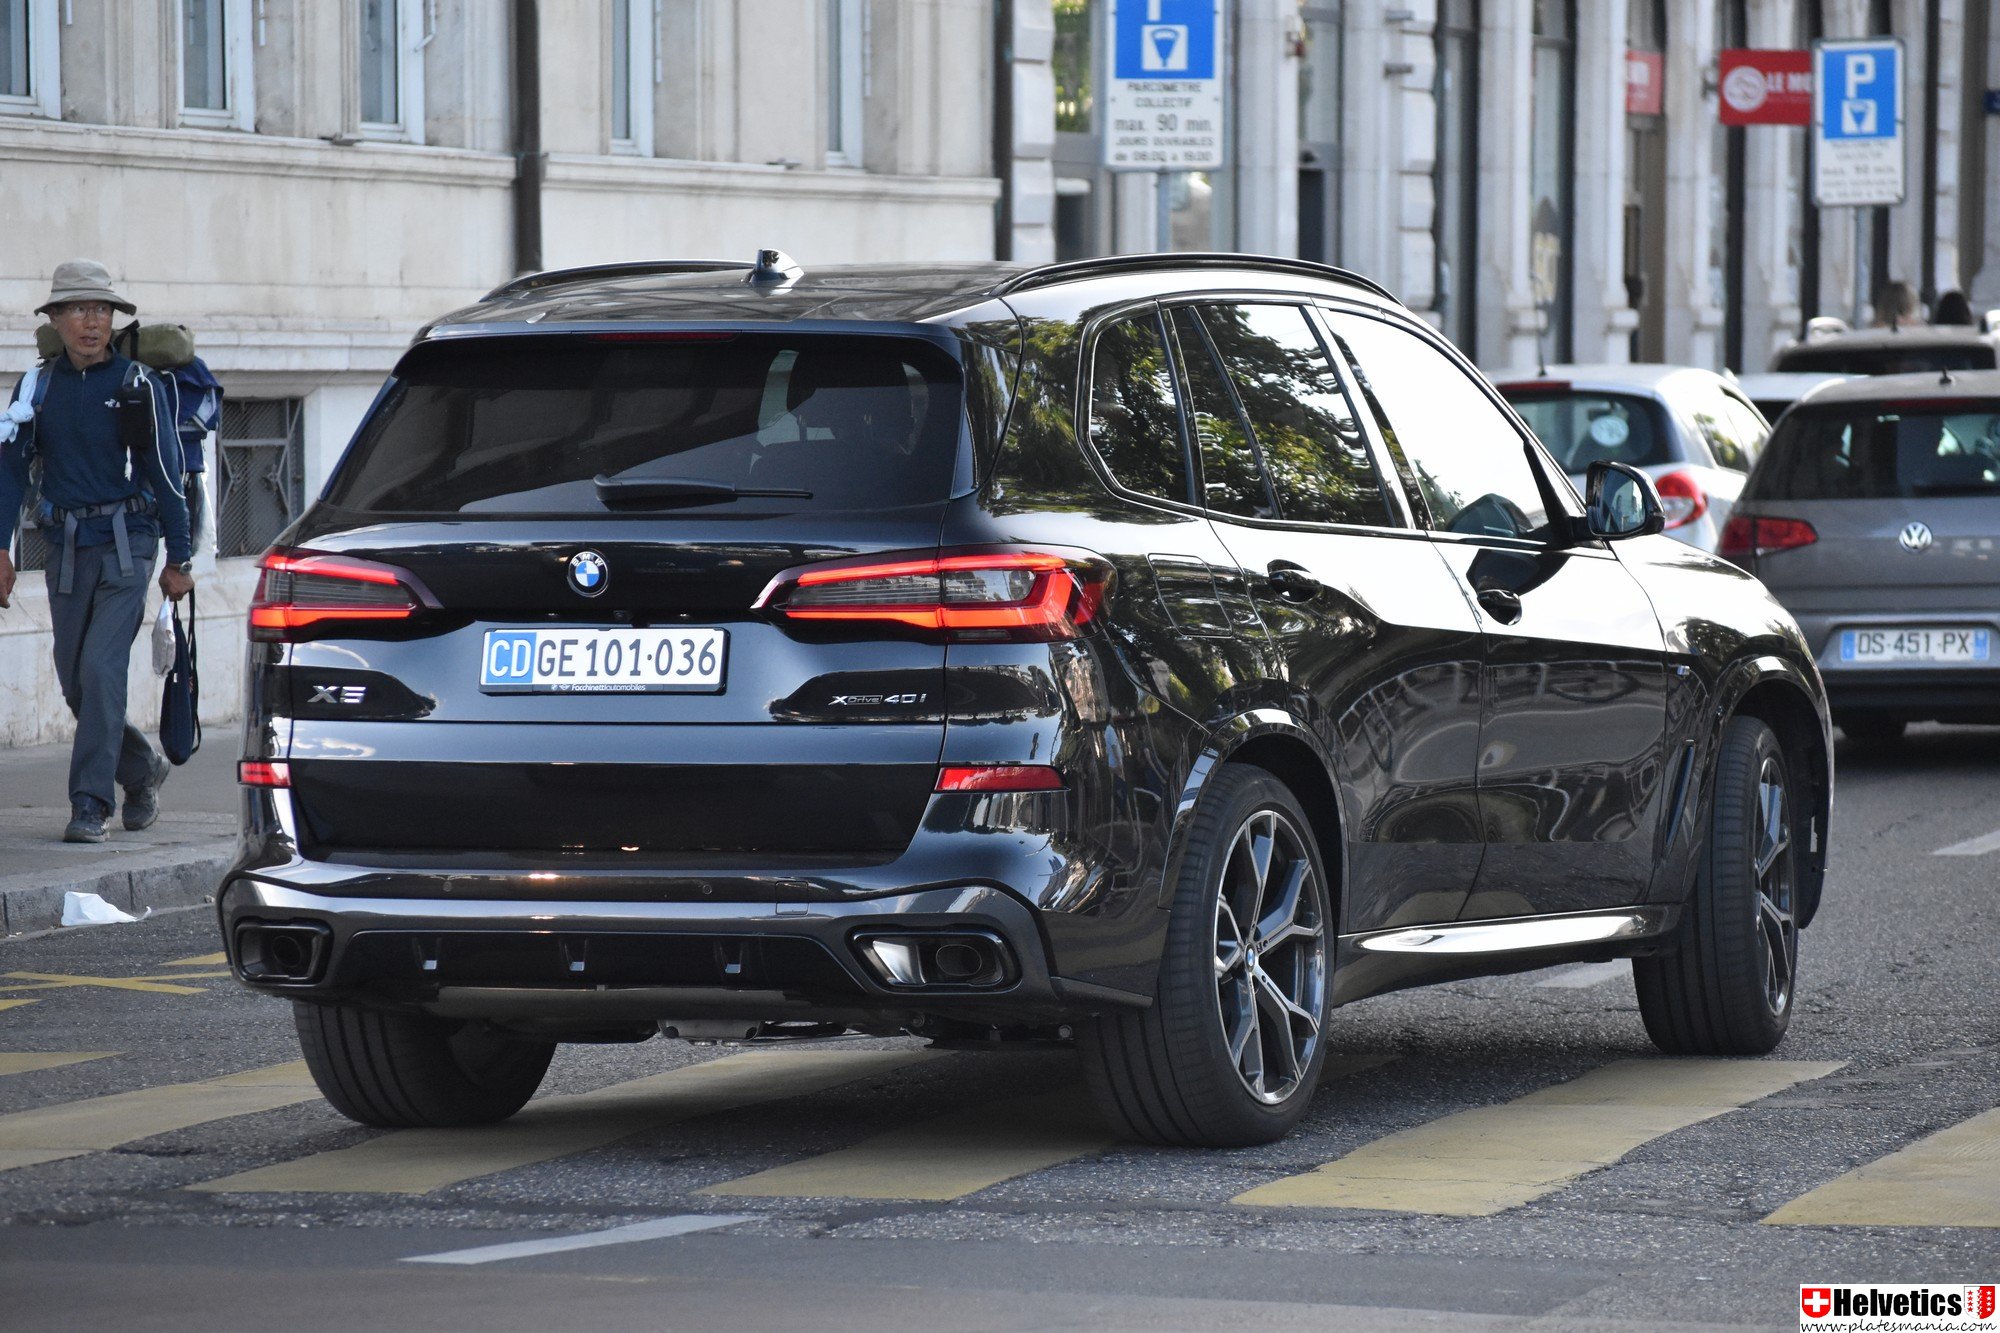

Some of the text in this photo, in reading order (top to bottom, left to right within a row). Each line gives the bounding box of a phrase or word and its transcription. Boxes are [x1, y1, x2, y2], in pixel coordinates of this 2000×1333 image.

[1845, 54, 1876, 98] P
[1135, 97, 1193, 108] COLLECTIF
[1156, 113, 1178, 131] 90
[1116, 136, 1148, 146] JOURS
[570, 552, 604, 567] BMW
[307, 685, 366, 703] X5
